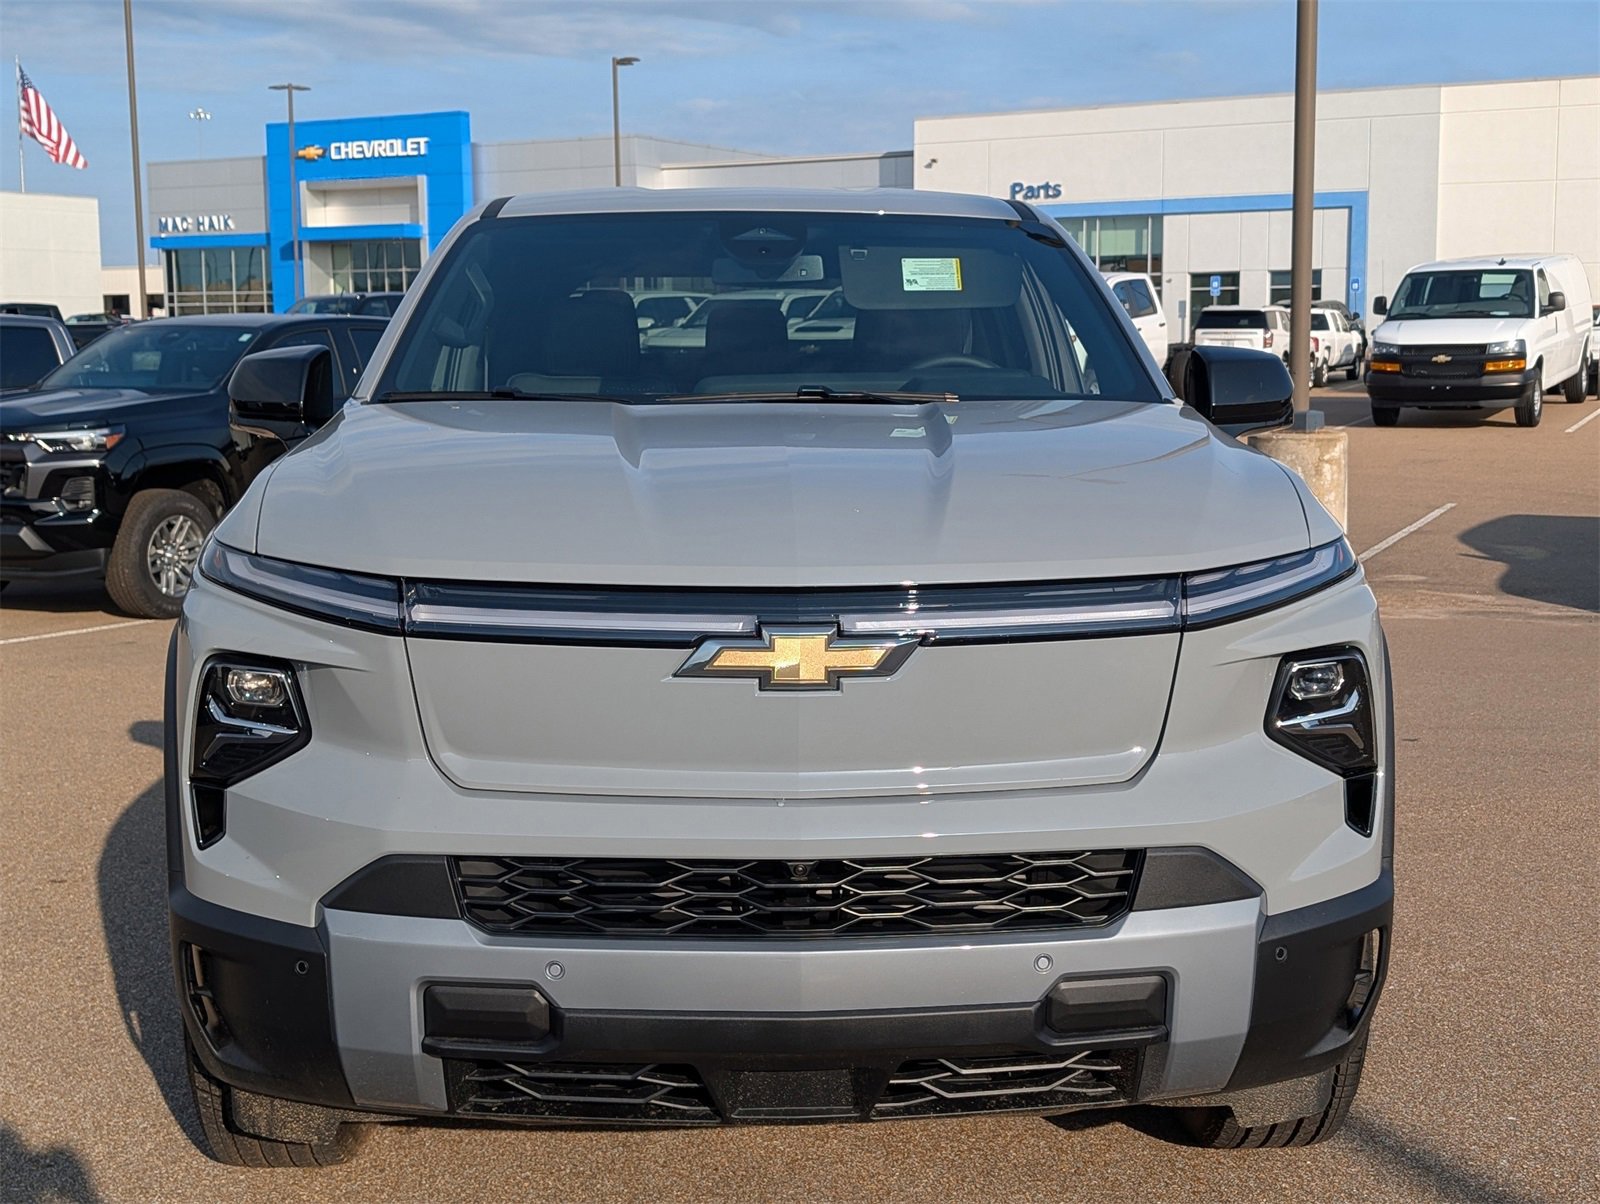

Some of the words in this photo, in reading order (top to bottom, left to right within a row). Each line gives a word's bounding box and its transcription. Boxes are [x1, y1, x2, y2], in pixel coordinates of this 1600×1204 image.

[330, 137, 429, 160] CHEVROLET
[1010, 181, 1062, 200] Parts
[159, 216, 192, 233] MAC
[197, 214, 235, 232] HAIK
